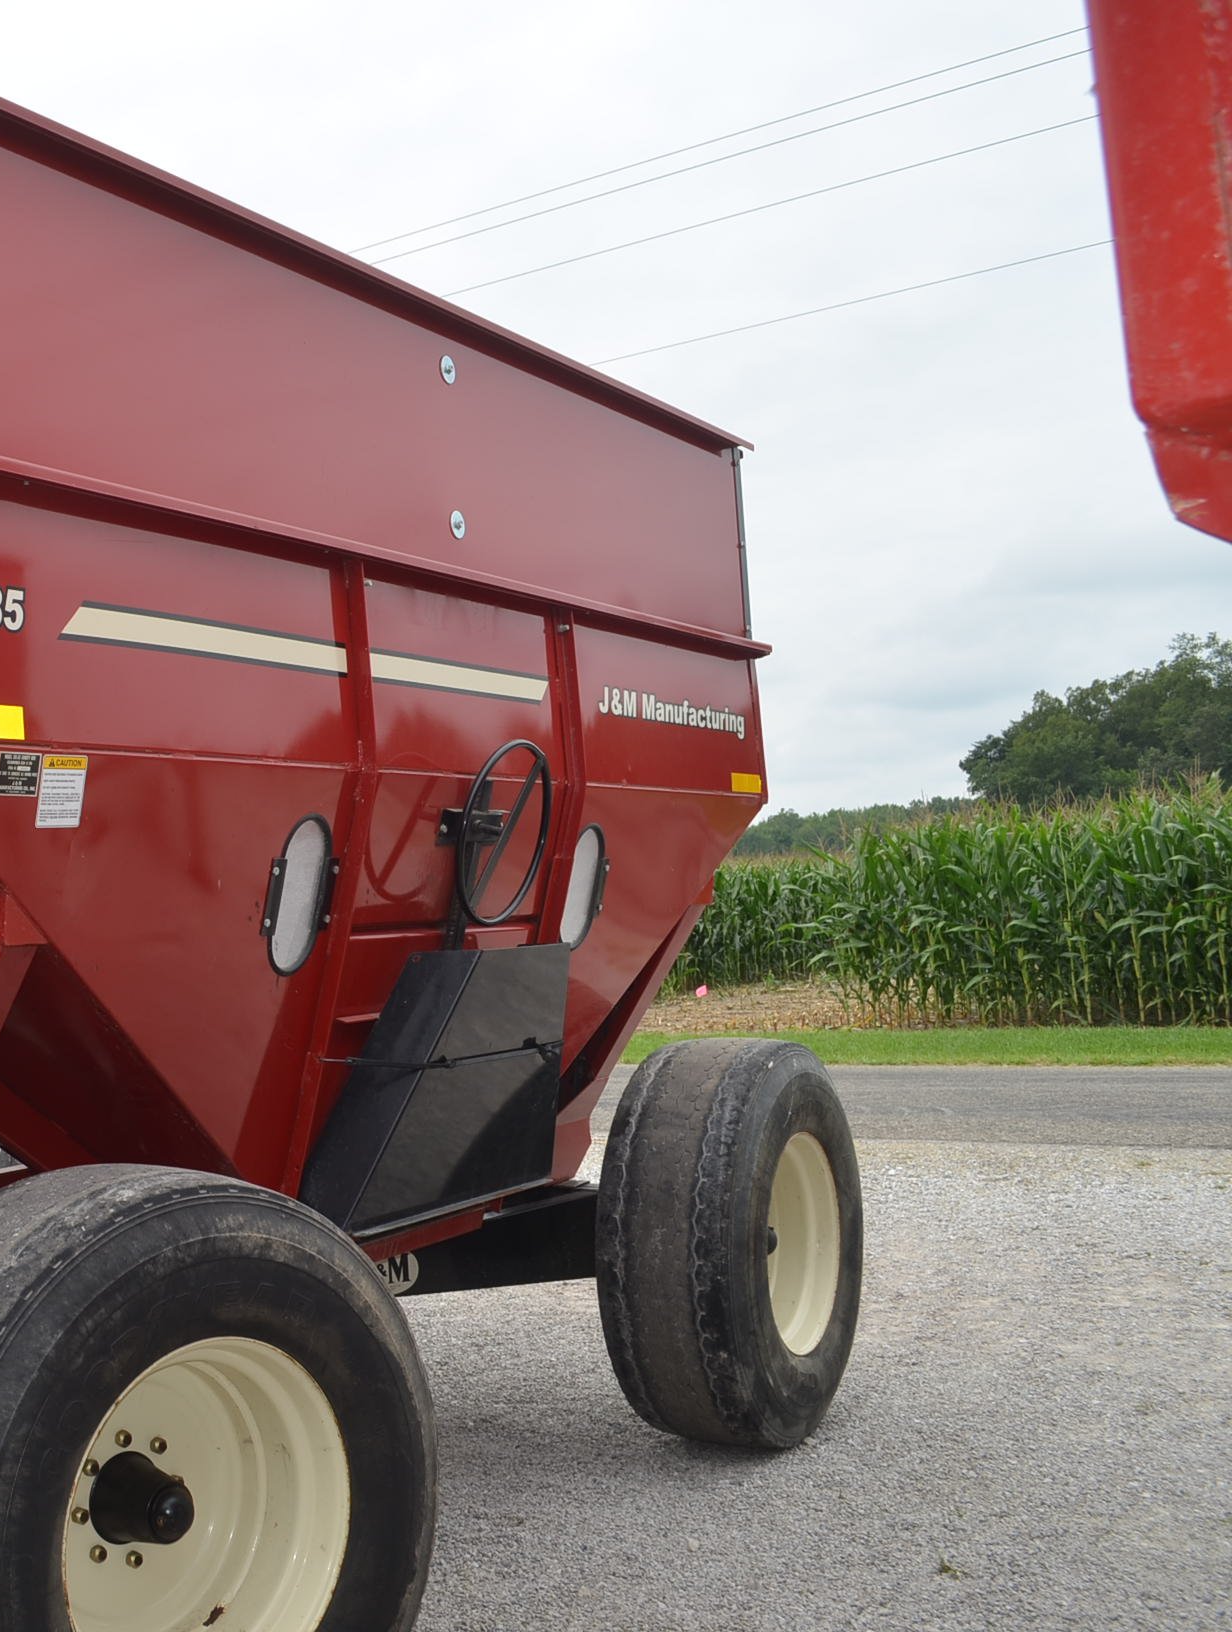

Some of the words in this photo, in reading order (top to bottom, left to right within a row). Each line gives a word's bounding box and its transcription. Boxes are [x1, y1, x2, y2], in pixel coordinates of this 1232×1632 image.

[598, 686, 637, 718] J&M
[642, 692, 745, 740] Manufacturing
[55, 759, 82, 767] CAUTION
[377, 1253, 411, 1284] &M
